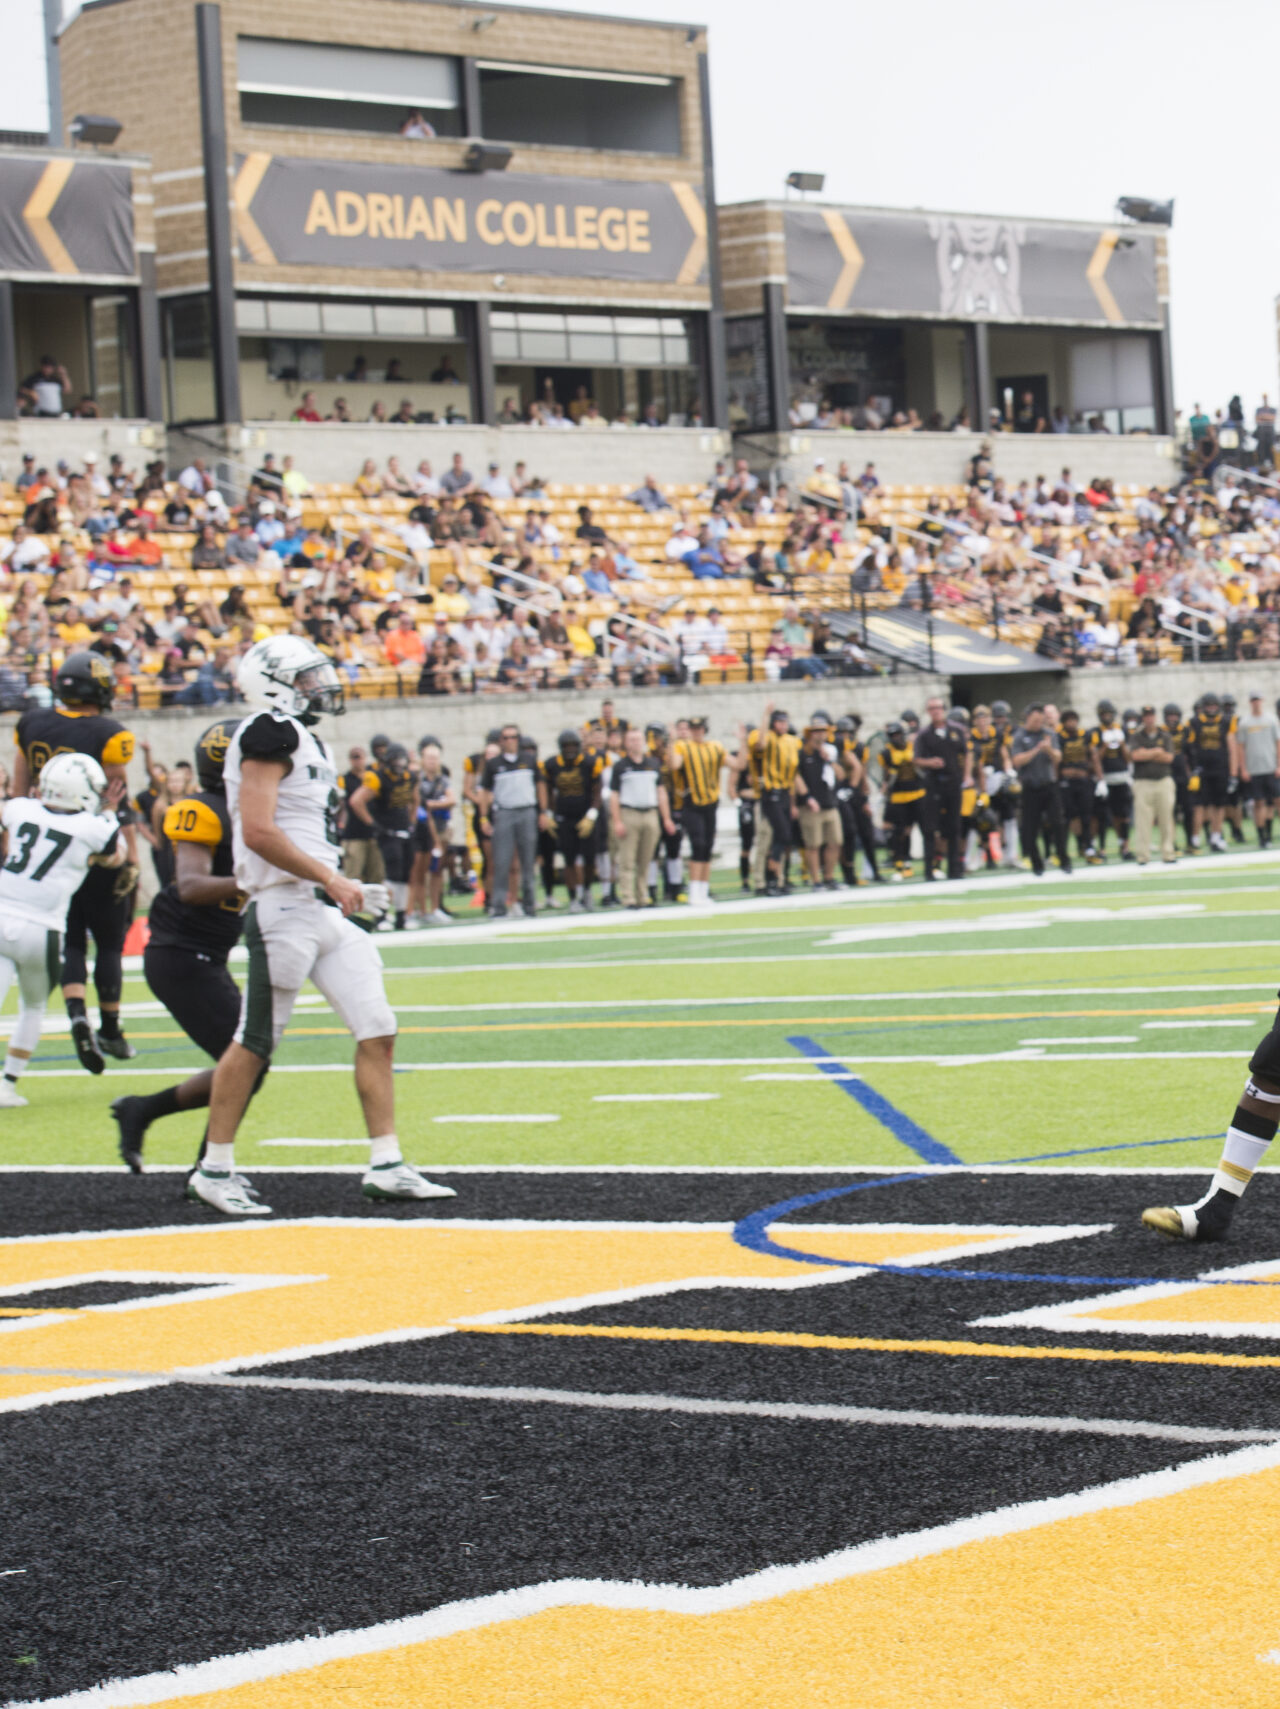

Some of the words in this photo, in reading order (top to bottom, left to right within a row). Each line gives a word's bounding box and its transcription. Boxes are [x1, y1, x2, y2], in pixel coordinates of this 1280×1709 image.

[304, 189, 468, 244] ADRIAN
[475, 198, 653, 254] COLLEGE
[174, 809, 198, 832] 10
[4, 821, 73, 882] 37
